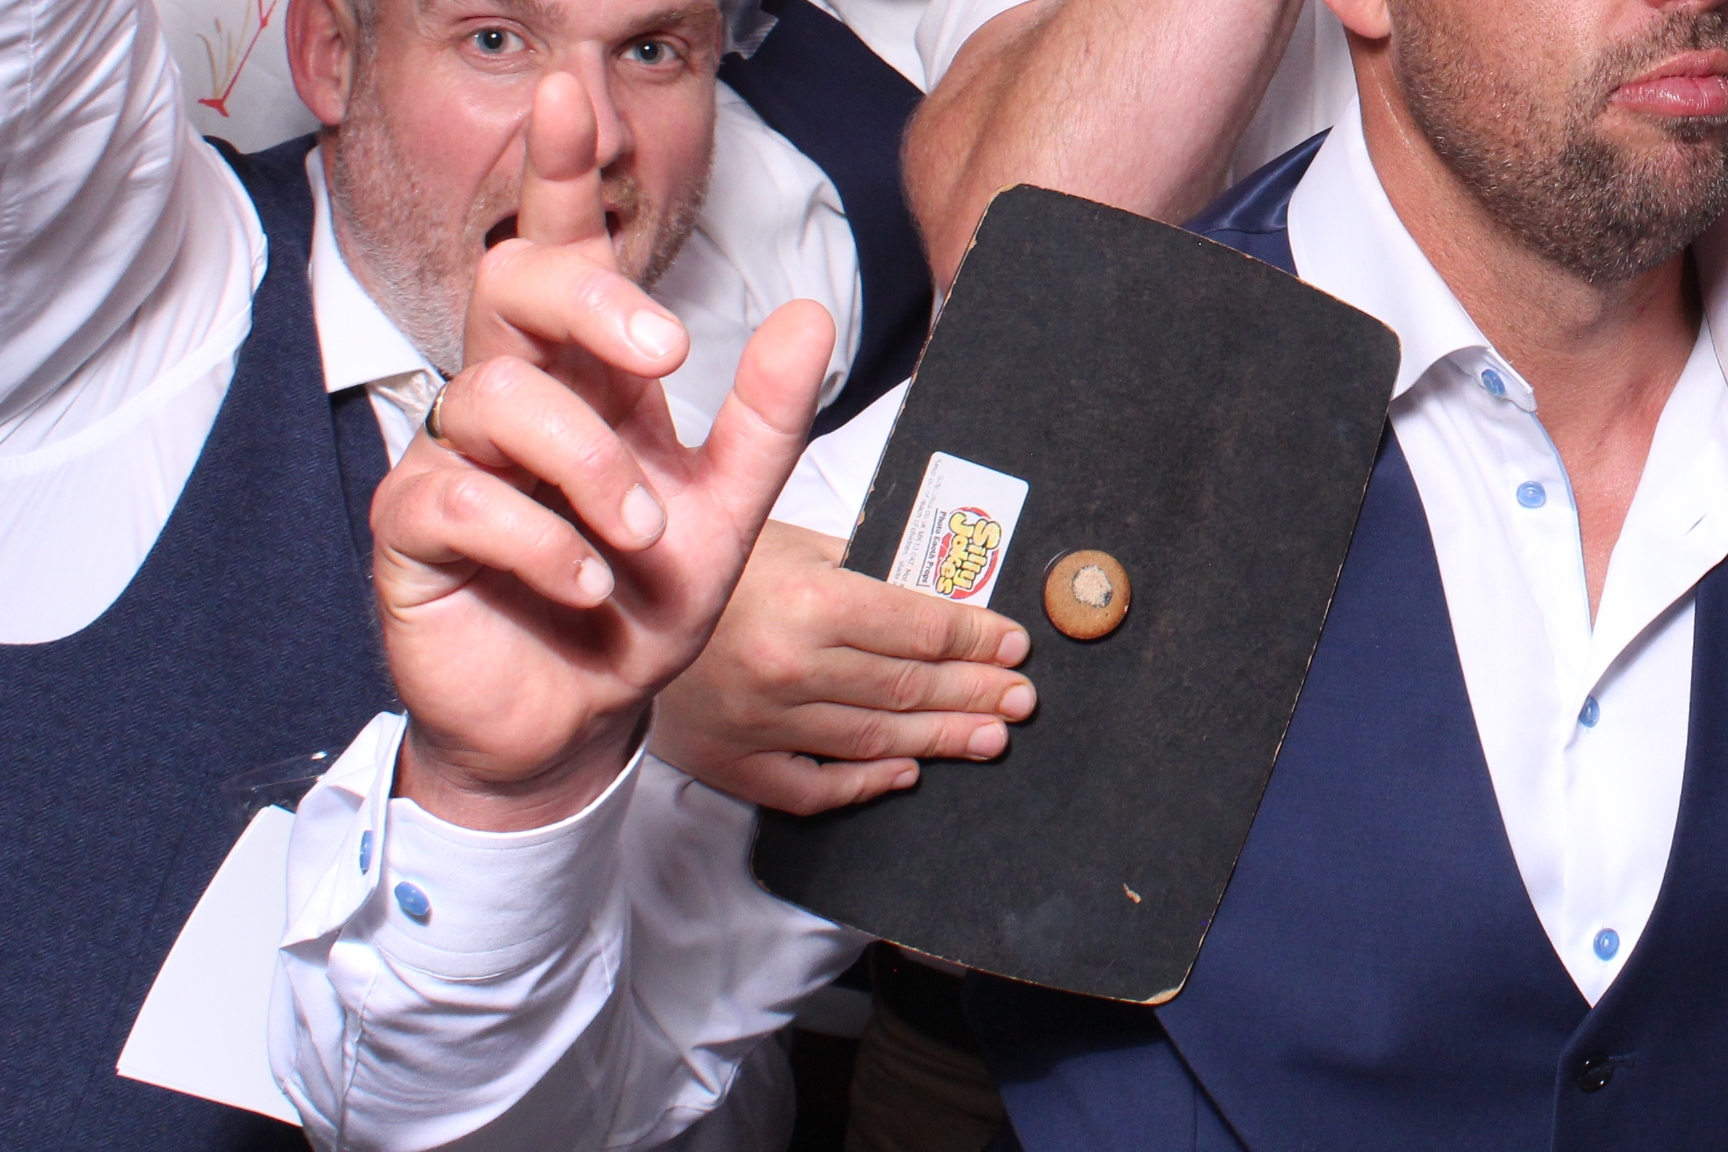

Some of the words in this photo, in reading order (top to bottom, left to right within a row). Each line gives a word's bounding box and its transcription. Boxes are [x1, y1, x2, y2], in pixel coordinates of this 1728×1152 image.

[935, 510, 947, 535] Photo
[922, 560, 934, 583] Props
[936, 512, 975, 595] Jokes
[953, 518, 1001, 590] Silly
